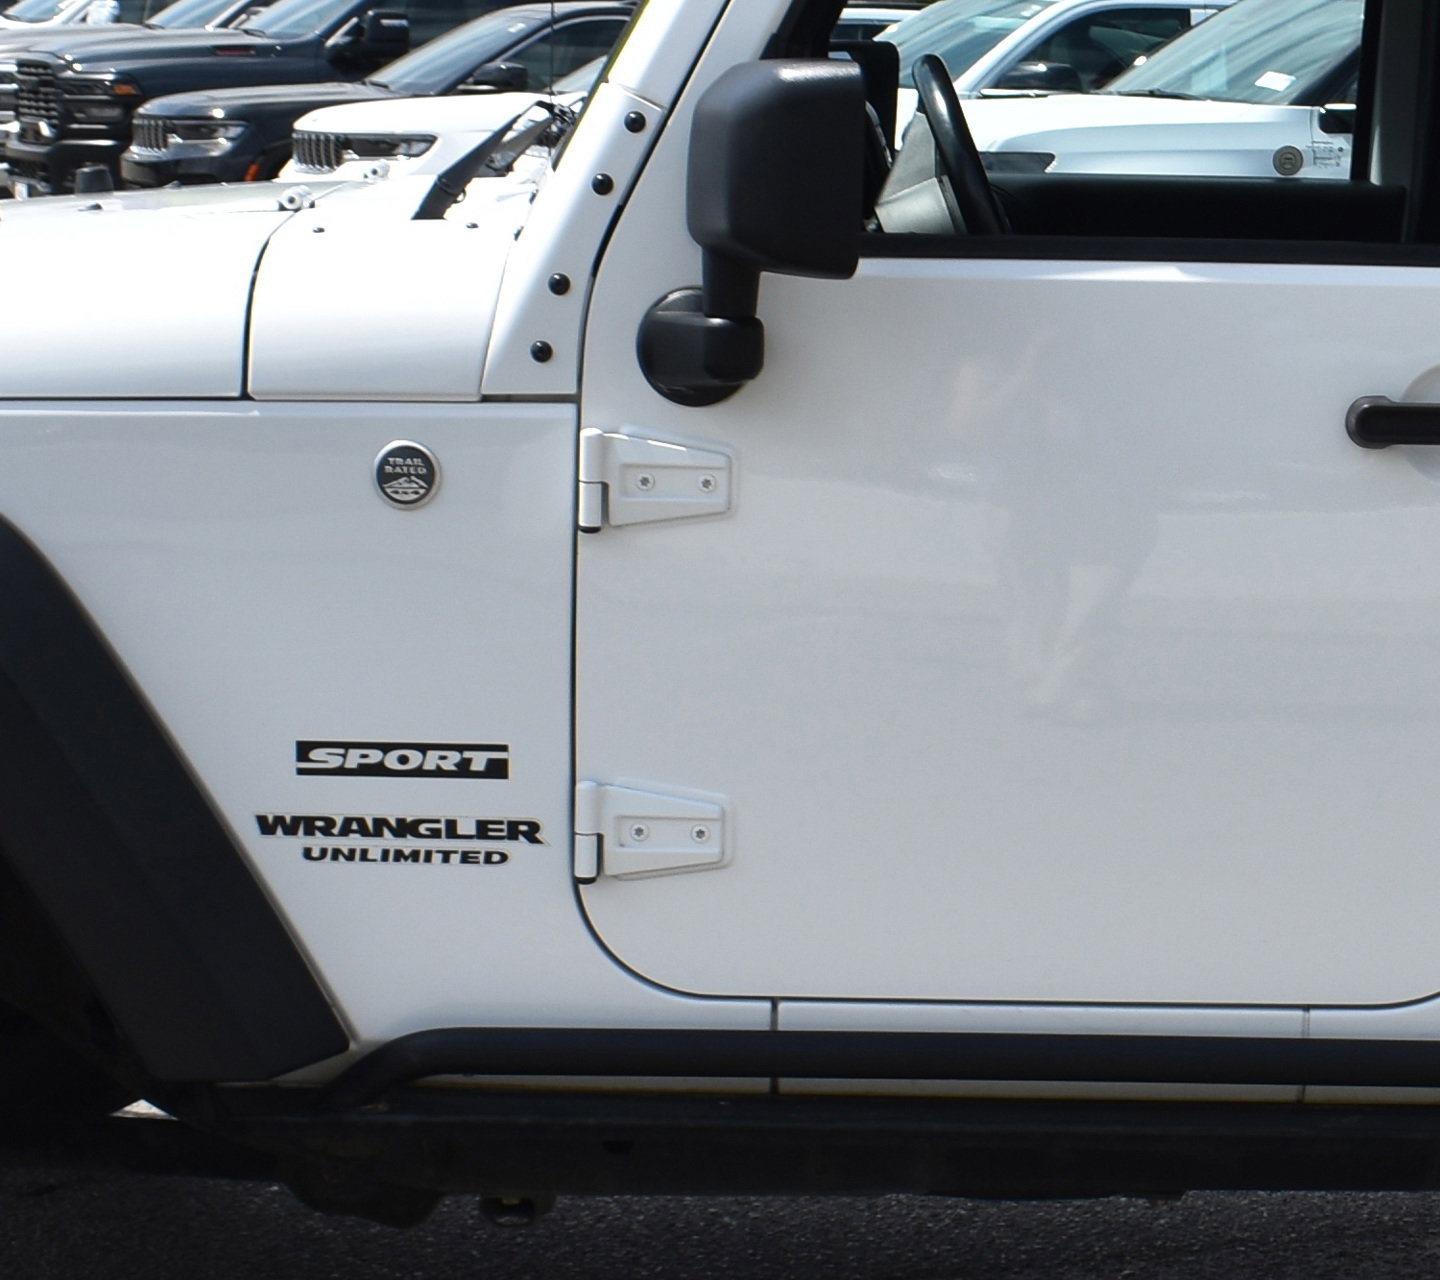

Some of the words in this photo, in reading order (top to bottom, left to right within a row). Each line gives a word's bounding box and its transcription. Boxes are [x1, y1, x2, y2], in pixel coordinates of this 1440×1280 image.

[384, 465, 427, 474] RATED
[387, 457, 425, 466] TRAIL
[296, 746, 509, 772] SPORT
[255, 814, 548, 845] WRANGLER
[302, 846, 509, 865] UNLIMITED
